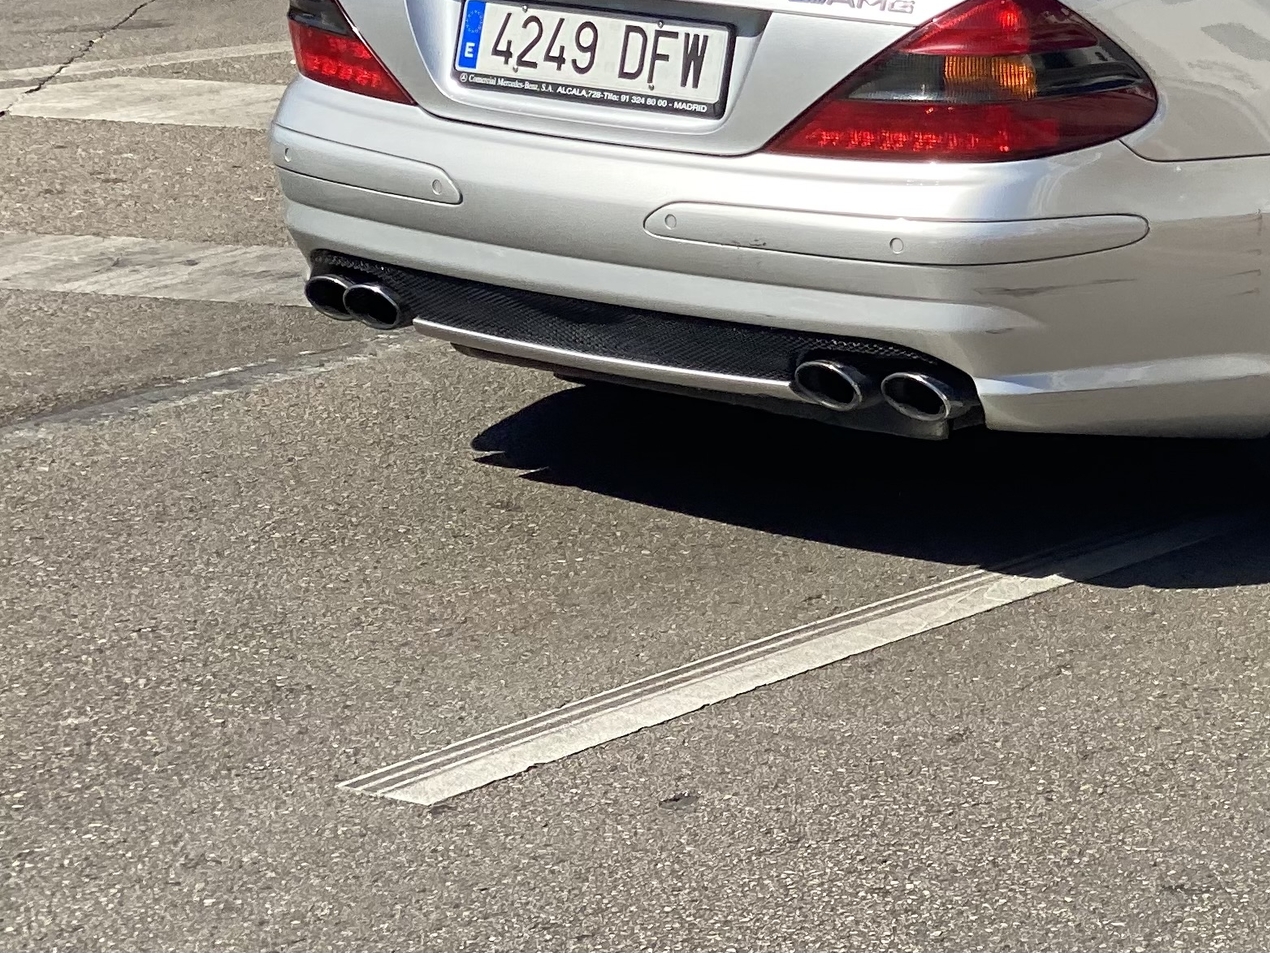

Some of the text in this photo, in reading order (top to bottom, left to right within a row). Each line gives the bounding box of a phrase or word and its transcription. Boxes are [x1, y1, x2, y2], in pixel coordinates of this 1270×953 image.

[464, 41, 475, 58] E
[491, 12, 709, 89] 4249 DFW
[469, 74, 497, 85] Comercial
[621, 94, 630, 102] 91
[631, 96, 645, 104] 324
[657, 99, 668, 108] 00
[673, 101, 708, 113] MADRID
